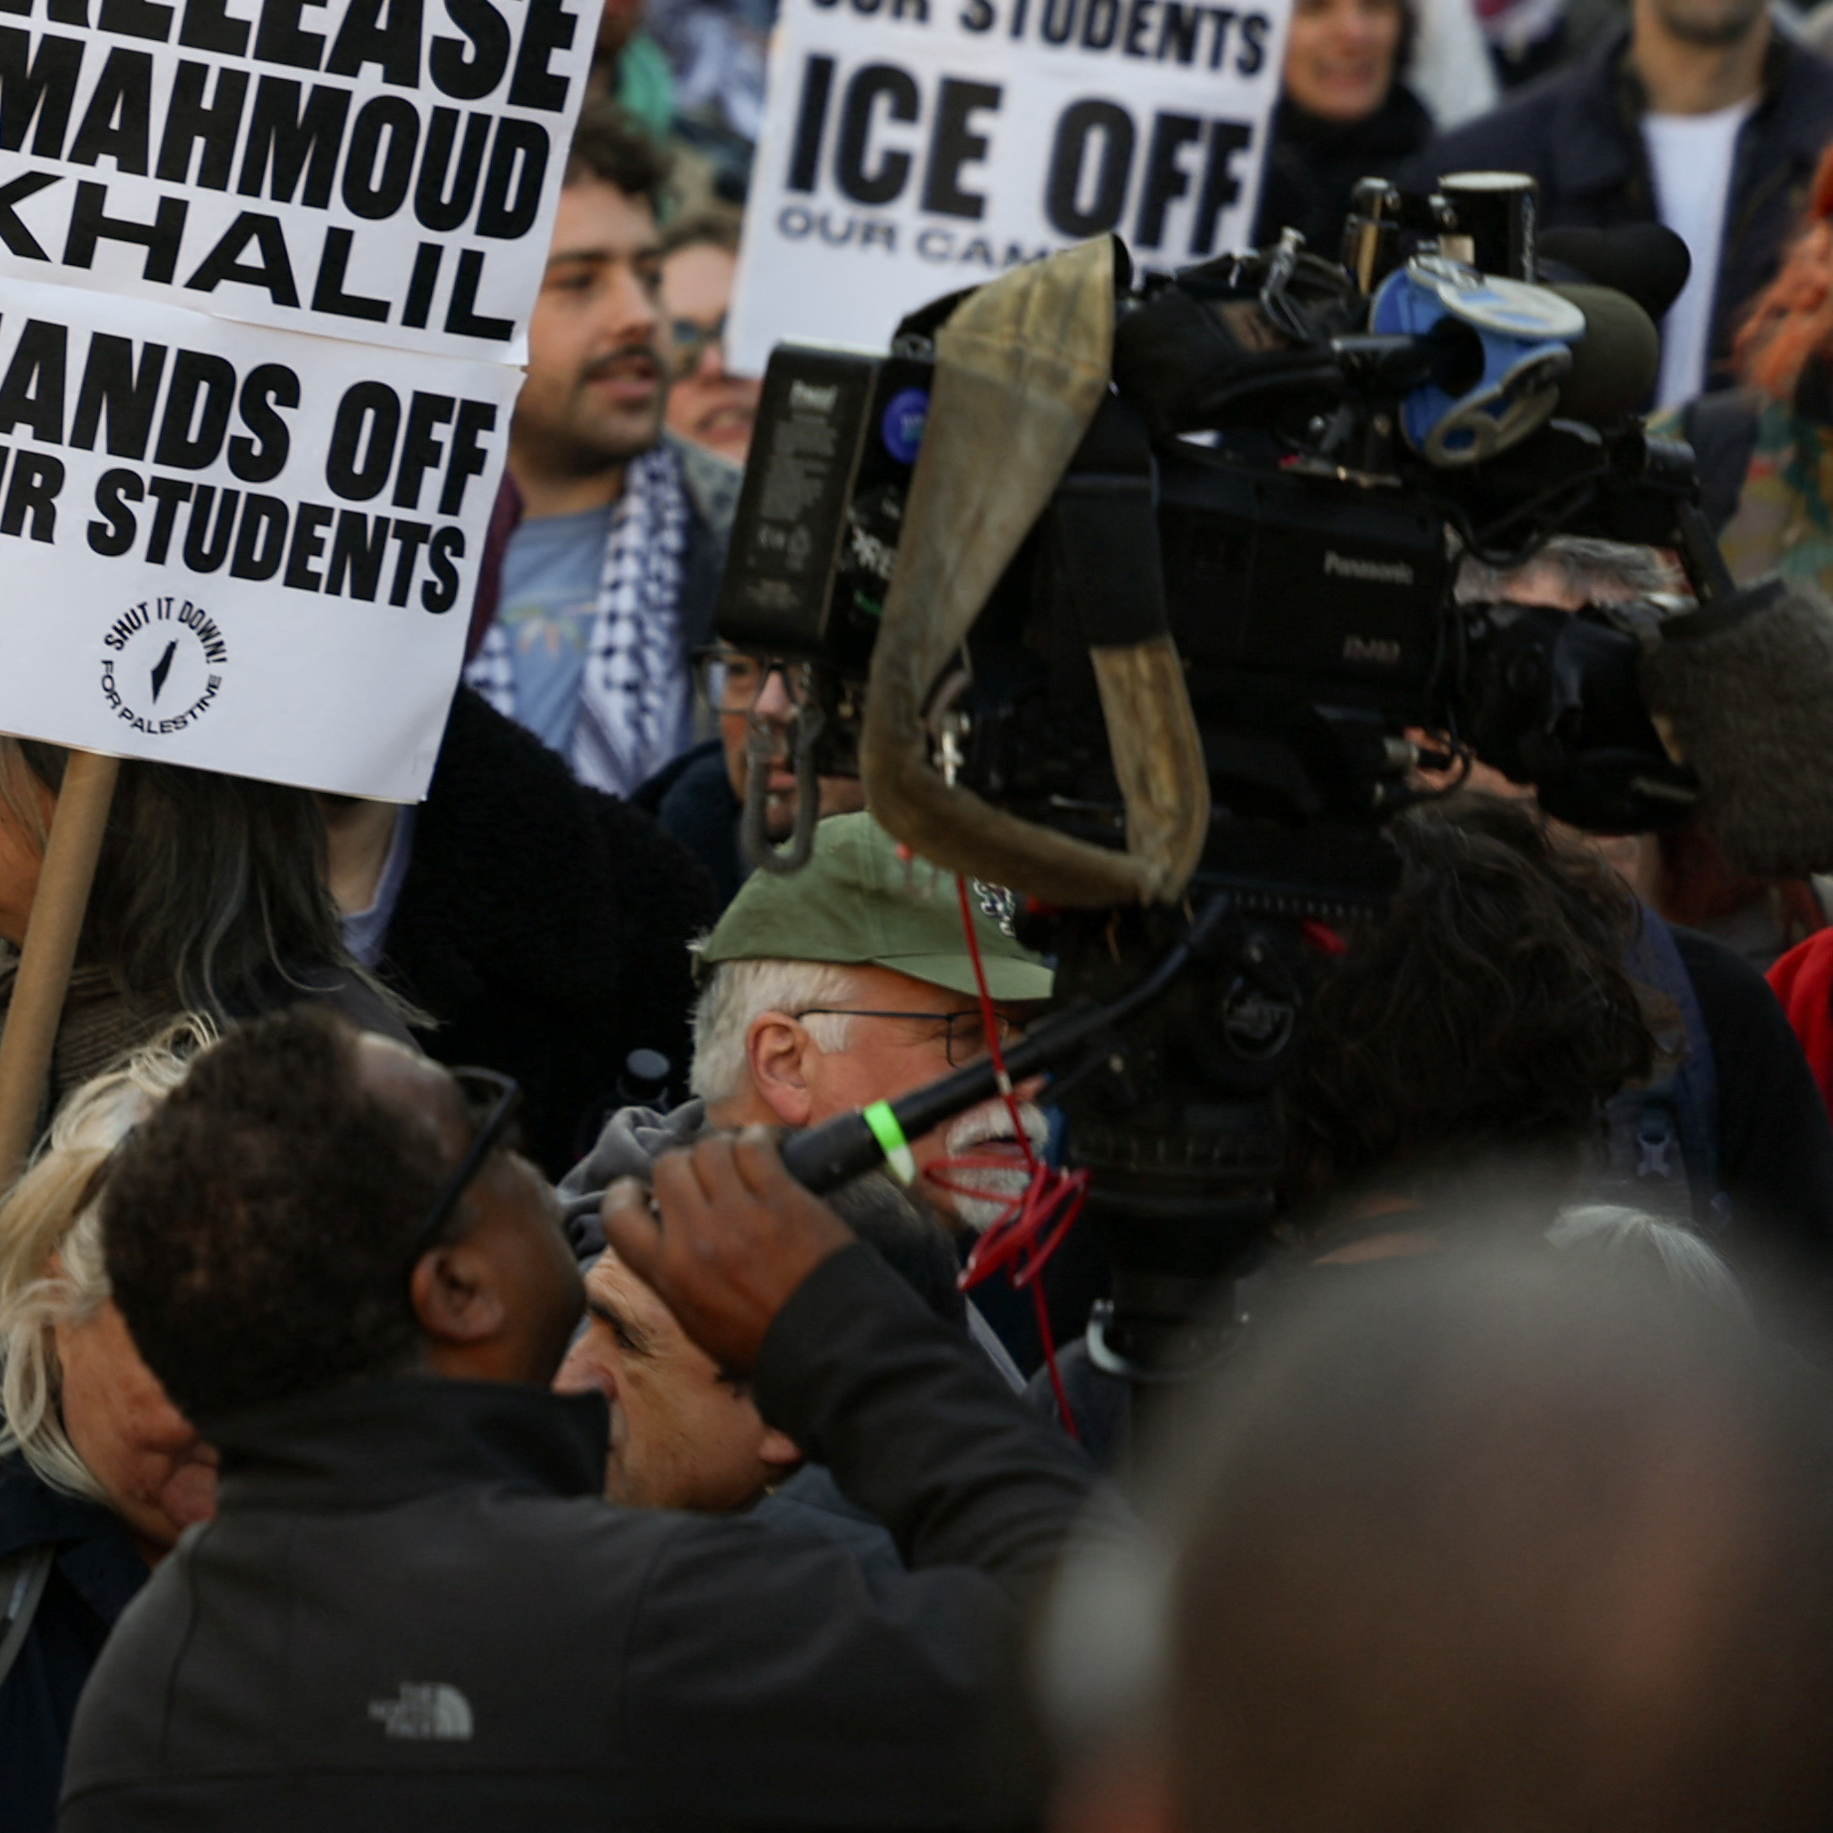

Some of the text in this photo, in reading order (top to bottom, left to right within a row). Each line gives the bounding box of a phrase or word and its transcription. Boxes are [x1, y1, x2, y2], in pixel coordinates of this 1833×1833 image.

[785, 52, 1257, 259] ICE OFF
[777, 206, 901, 252] OUR
[325, 380, 497, 516] OFF
[86, 468, 467, 614] STUDENTS
[104, 597, 228, 665] SHUT IT DOWN!
[101, 659, 222, 734] FOR PALESTINE
